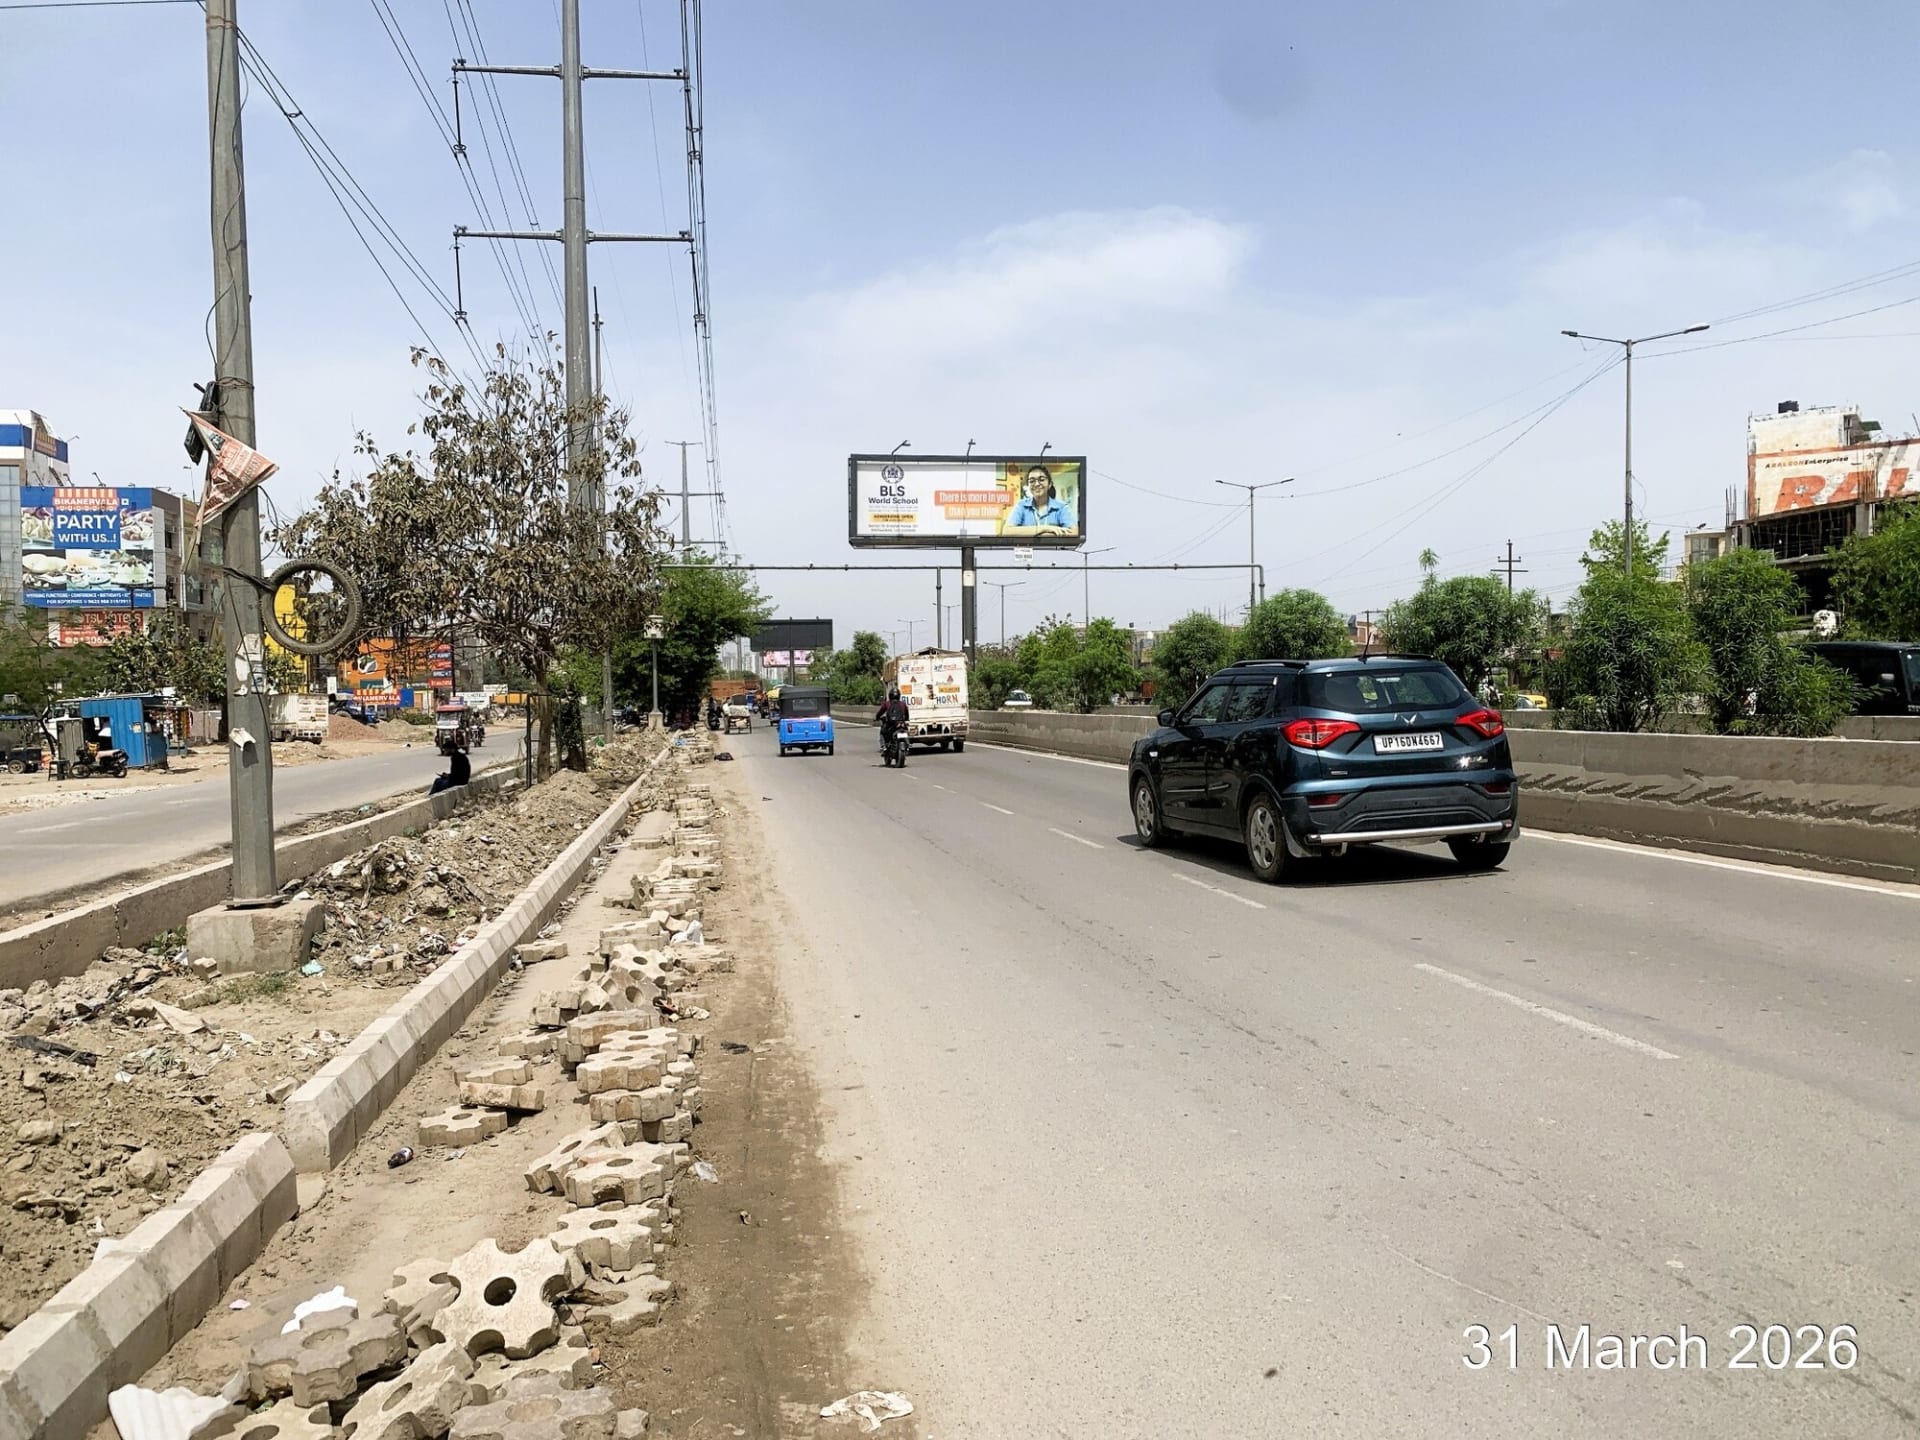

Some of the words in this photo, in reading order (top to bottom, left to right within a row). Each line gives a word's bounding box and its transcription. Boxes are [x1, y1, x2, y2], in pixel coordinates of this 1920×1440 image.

[880, 485, 905, 496] BLS
[55, 498, 118, 506] BIKANERVALA
[57, 515, 117, 529] PARTY
[58, 534, 89, 543] WITH
[936, 695, 958, 704] HORN
[1382, 734, 1440, 748] UP16DN4667
